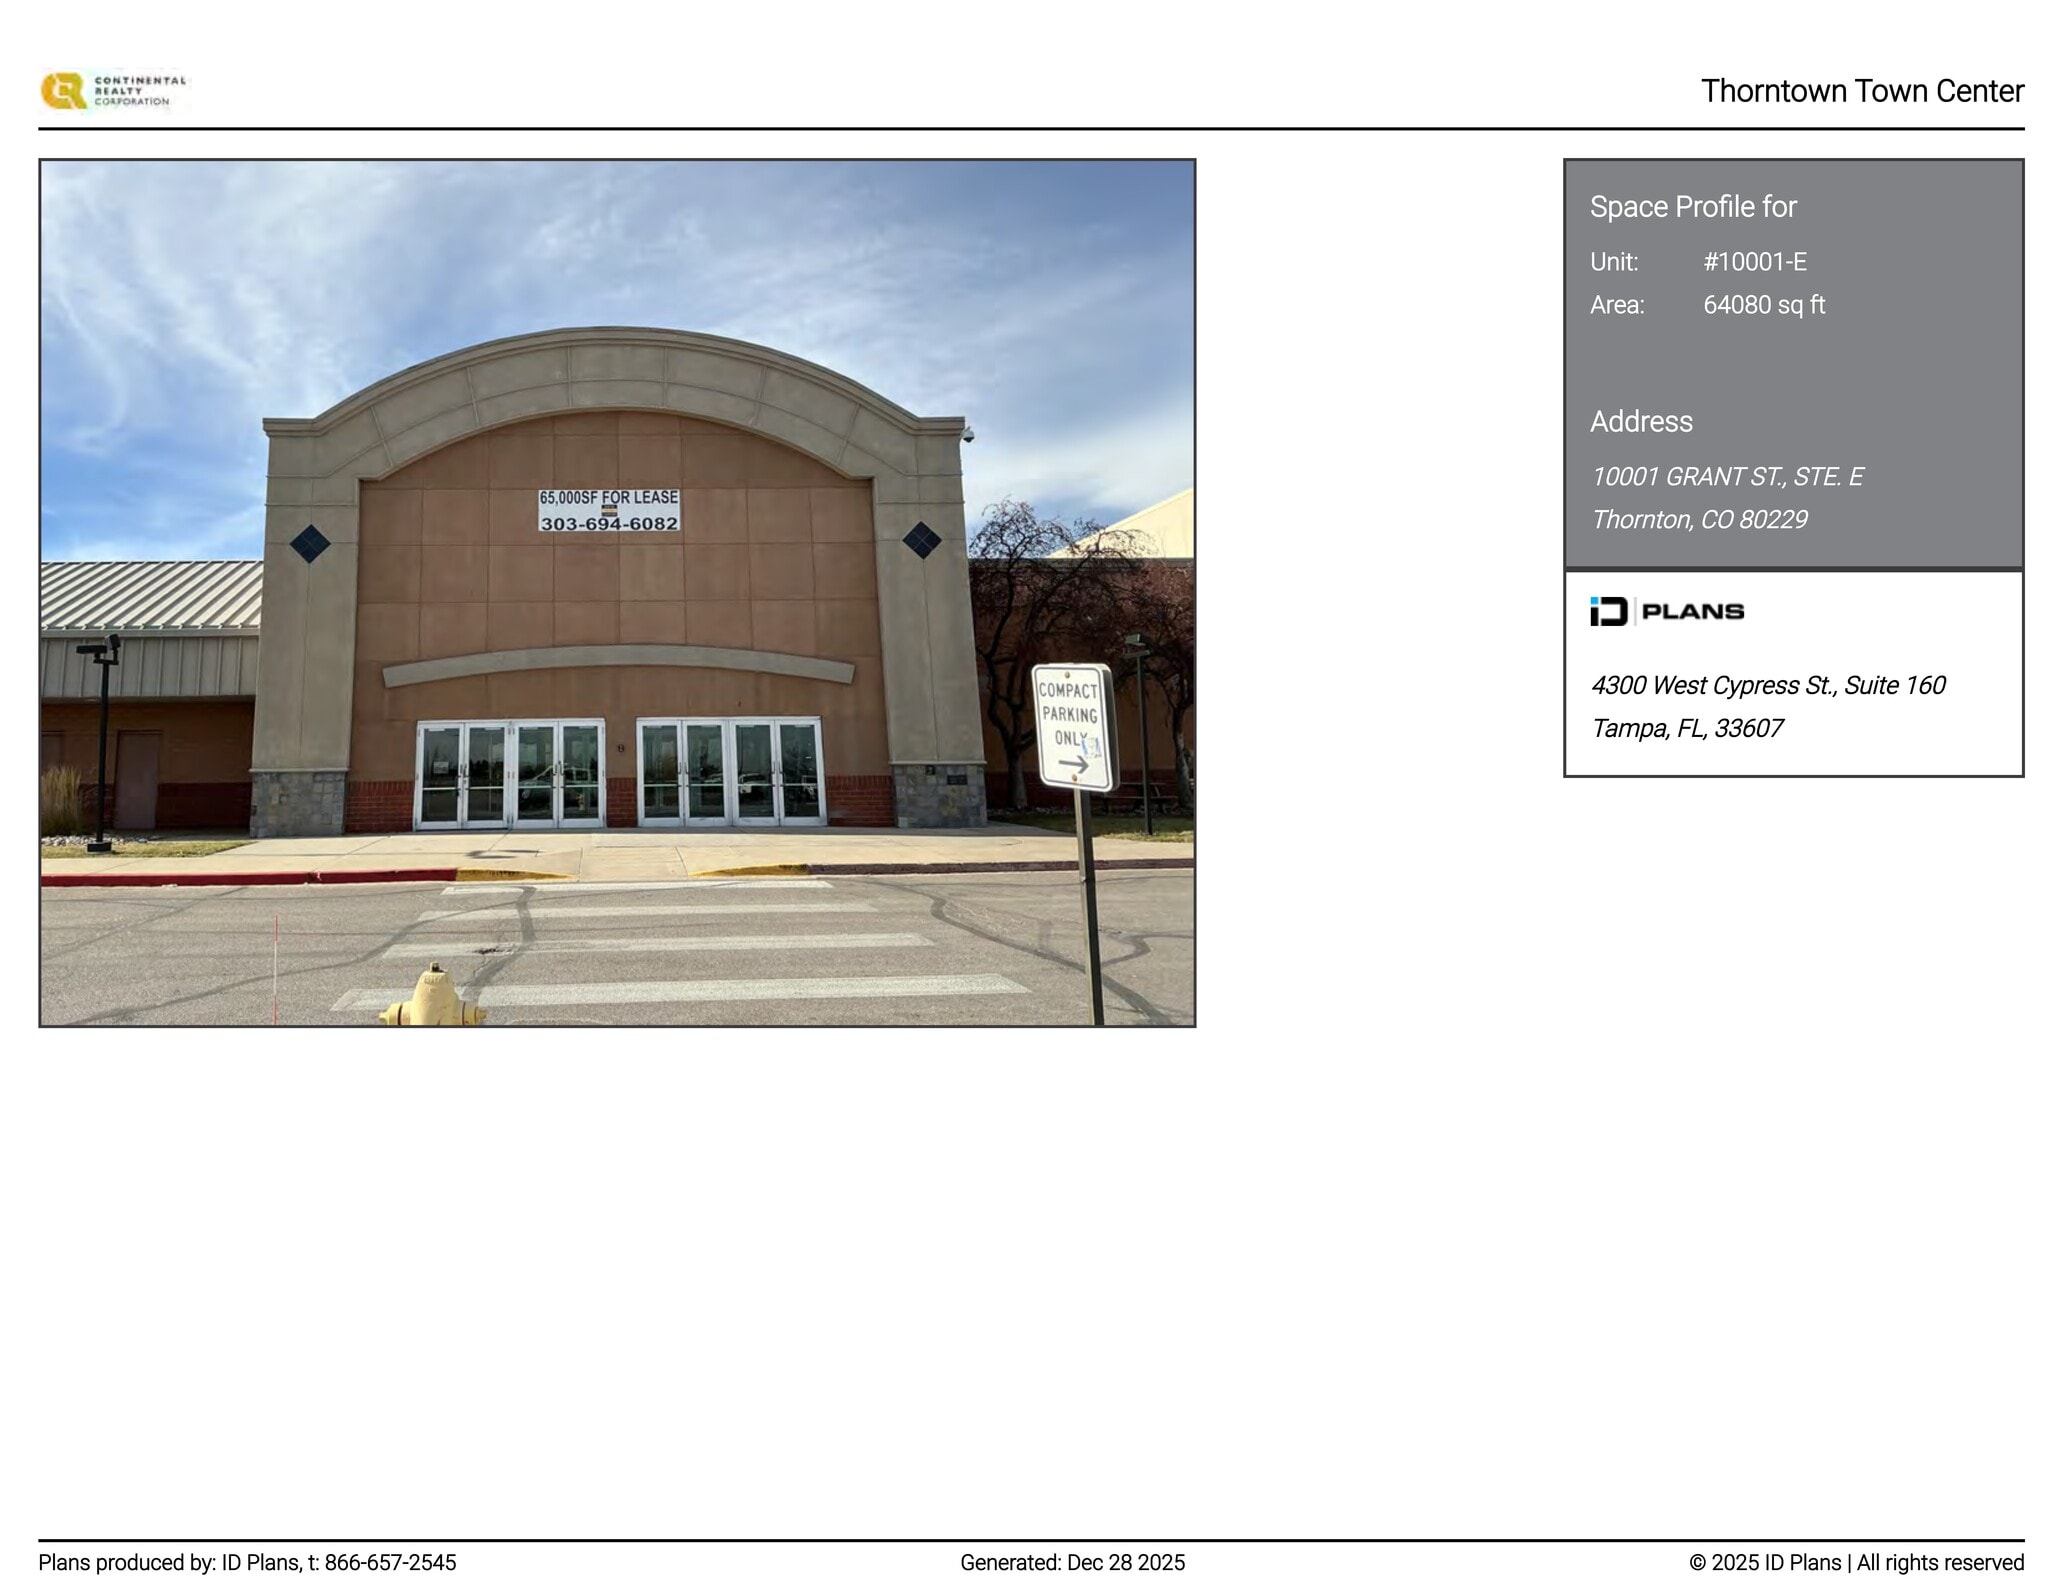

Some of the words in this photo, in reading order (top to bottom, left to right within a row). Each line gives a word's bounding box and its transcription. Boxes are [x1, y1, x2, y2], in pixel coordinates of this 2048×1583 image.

[94, 76, 187, 85] CONTINENTAL
[1701, 78, 1847, 102] Thorntown
[1855, 78, 1928, 102] Town
[1937, 78, 2025, 102] Center
[94, 86, 142, 96] REALTY
[94, 97, 170, 106] CORPORATION
[1590, 194, 1668, 223] Space
[1676, 194, 1755, 218] Profile
[1763, 194, 1798, 218] for
[1591, 252, 1638, 271] Unit:
[1704, 252, 1807, 272] #10001-E
[1590, 295, 1644, 314] Area:
[1704, 295, 1771, 314] 64080
[1778, 299, 1803, 318] sq
[1810, 294, 1826, 314] ft
[1590, 409, 1693, 432] Address
[1594, 467, 1659, 486] 10001
[1667, 467, 1748, 486] GRANT
[1750, 467, 1787, 488] ST.,
[1793, 467, 1841, 486] STE.
[1849, 467, 1866, 486] E
[540, 490, 598, 506] 65,000SF
[602, 490, 630, 504] FOR
[634, 490, 678, 504] LEASE
[541, 517, 678, 531] 303-694-6082
[1594, 509, 1694, 531] Thornton,
[1702, 509, 1734, 529] CO
[1740, 509, 1808, 529] 80229
[1642, 603, 1745, 620] PLANS
[1039, 682, 1098, 699] COMPACT
[1592, 675, 1648, 694] 4300
[1654, 675, 1708, 694] West
[1713, 675, 1800, 699] Cypress
[1805, 675, 1838, 698] St.,
[1844, 675, 1899, 694] Suite
[1908, 675, 1947, 694] 160
[1043, 706, 1098, 724] PARKING
[1594, 718, 1671, 742] Tampa,
[1677, 718, 1708, 741] FL,
[1714, 718, 1786, 738] 33607
[38, 1553, 90, 1572] Plans
[96, 1553, 184, 1576] produced
[190, 1553, 217, 1576] by:
[222, 1553, 242, 1572] ID
[247, 1553, 303, 1574] Plans,
[308, 1555, 320, 1572] t:
[325, 1553, 457, 1572] 866-657-2545
[961, 1553, 1062, 1572] Generated:
[1068, 1553, 1104, 1572] Dec
[1109, 1553, 1132, 1572] 28
[1138, 1553, 1186, 1572] 2025
[1712, 1553, 1760, 1572] 2025
[1765, 1553, 1785, 1572] ID
[1790, 1553, 1842, 1572] Plans
[1857, 1553, 1880, 1572] All
[1885, 1553, 1939, 1576] rights
[1944, 1553, 2025, 1572] reserved
